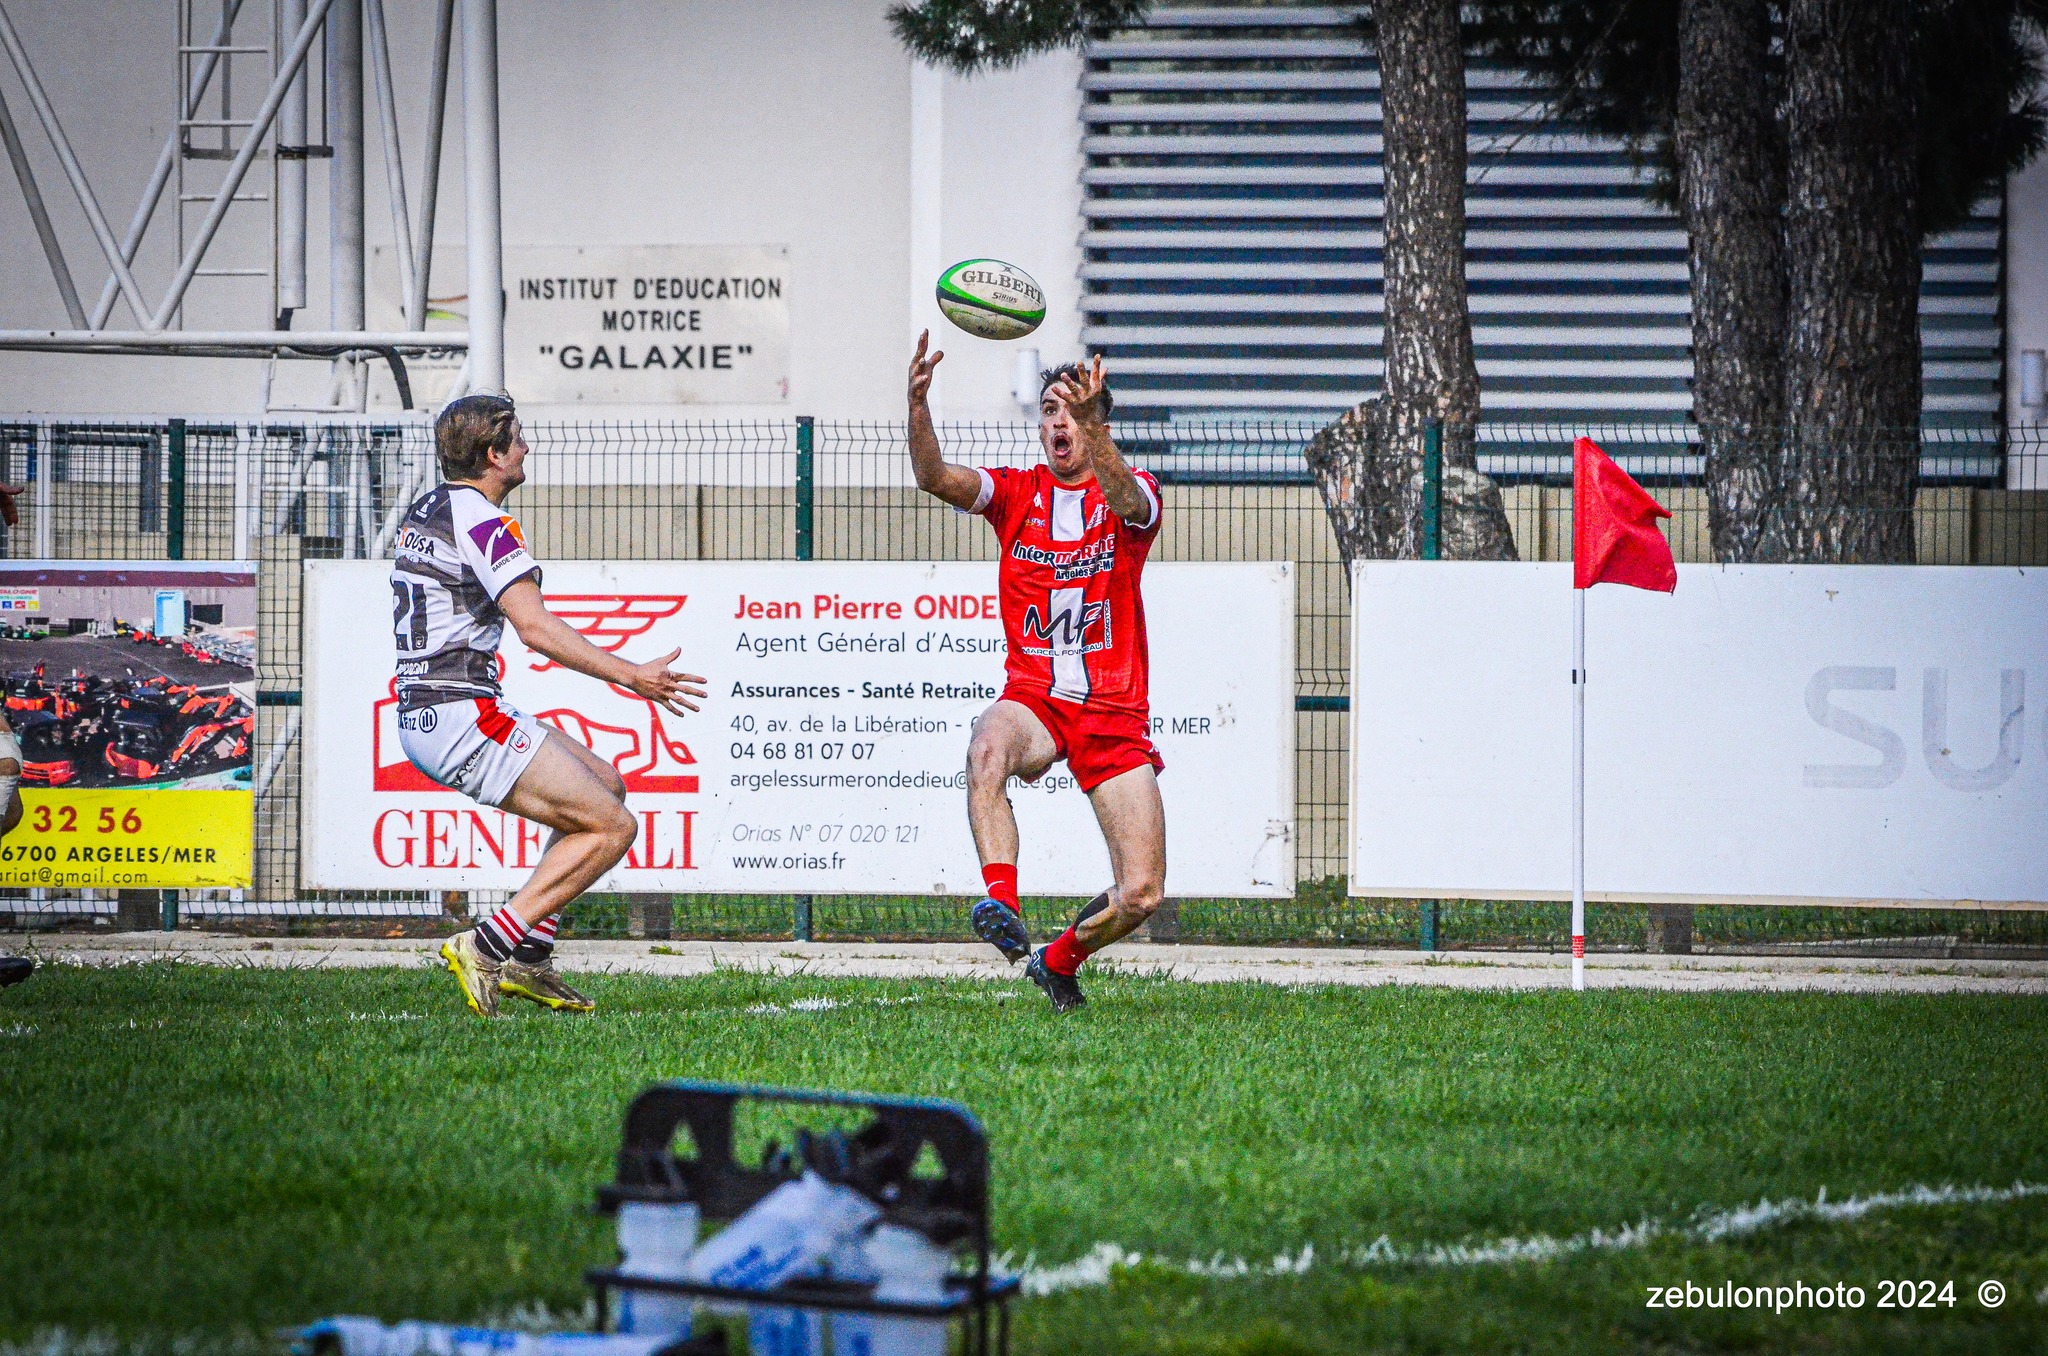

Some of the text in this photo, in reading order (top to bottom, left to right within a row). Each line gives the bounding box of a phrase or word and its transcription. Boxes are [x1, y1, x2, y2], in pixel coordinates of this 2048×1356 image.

[520, 277, 781, 299] INSTITUT D'EDUCATION
[961, 270, 1042, 305] GILBERT
[602, 310, 701, 331] MOTRICE
[539, 345, 753, 370] "GALAXIE"
[394, 526, 435, 557] SOUSA
[734, 594, 1002, 619] Jean Pierre ONDE
[736, 632, 807, 658] Agent
[817, 632, 905, 653] Général
[731, 682, 840, 698] Assurances
[862, 682, 915, 699] Santé
[922, 682, 996, 699] Retraite
[730, 715, 759, 735] 40,
[767, 719, 792, 733] av.
[800, 715, 824, 733] de
[832, 715, 847, 733] la
[855, 715, 947, 733] Libération
[1172, 717, 1211, 734] MER
[1803, 665, 2048, 792] SU
[730, 742, 875, 760] 04 68 81 07 07
[33, 805, 142, 834] 32 56
[373, 809, 699, 870] GENELI
[732, 824, 919, 842] Orias N° 07 020 121
[66, 847, 217, 863] ARGELES/MER
[732, 852, 846, 869] www.orias.fr
